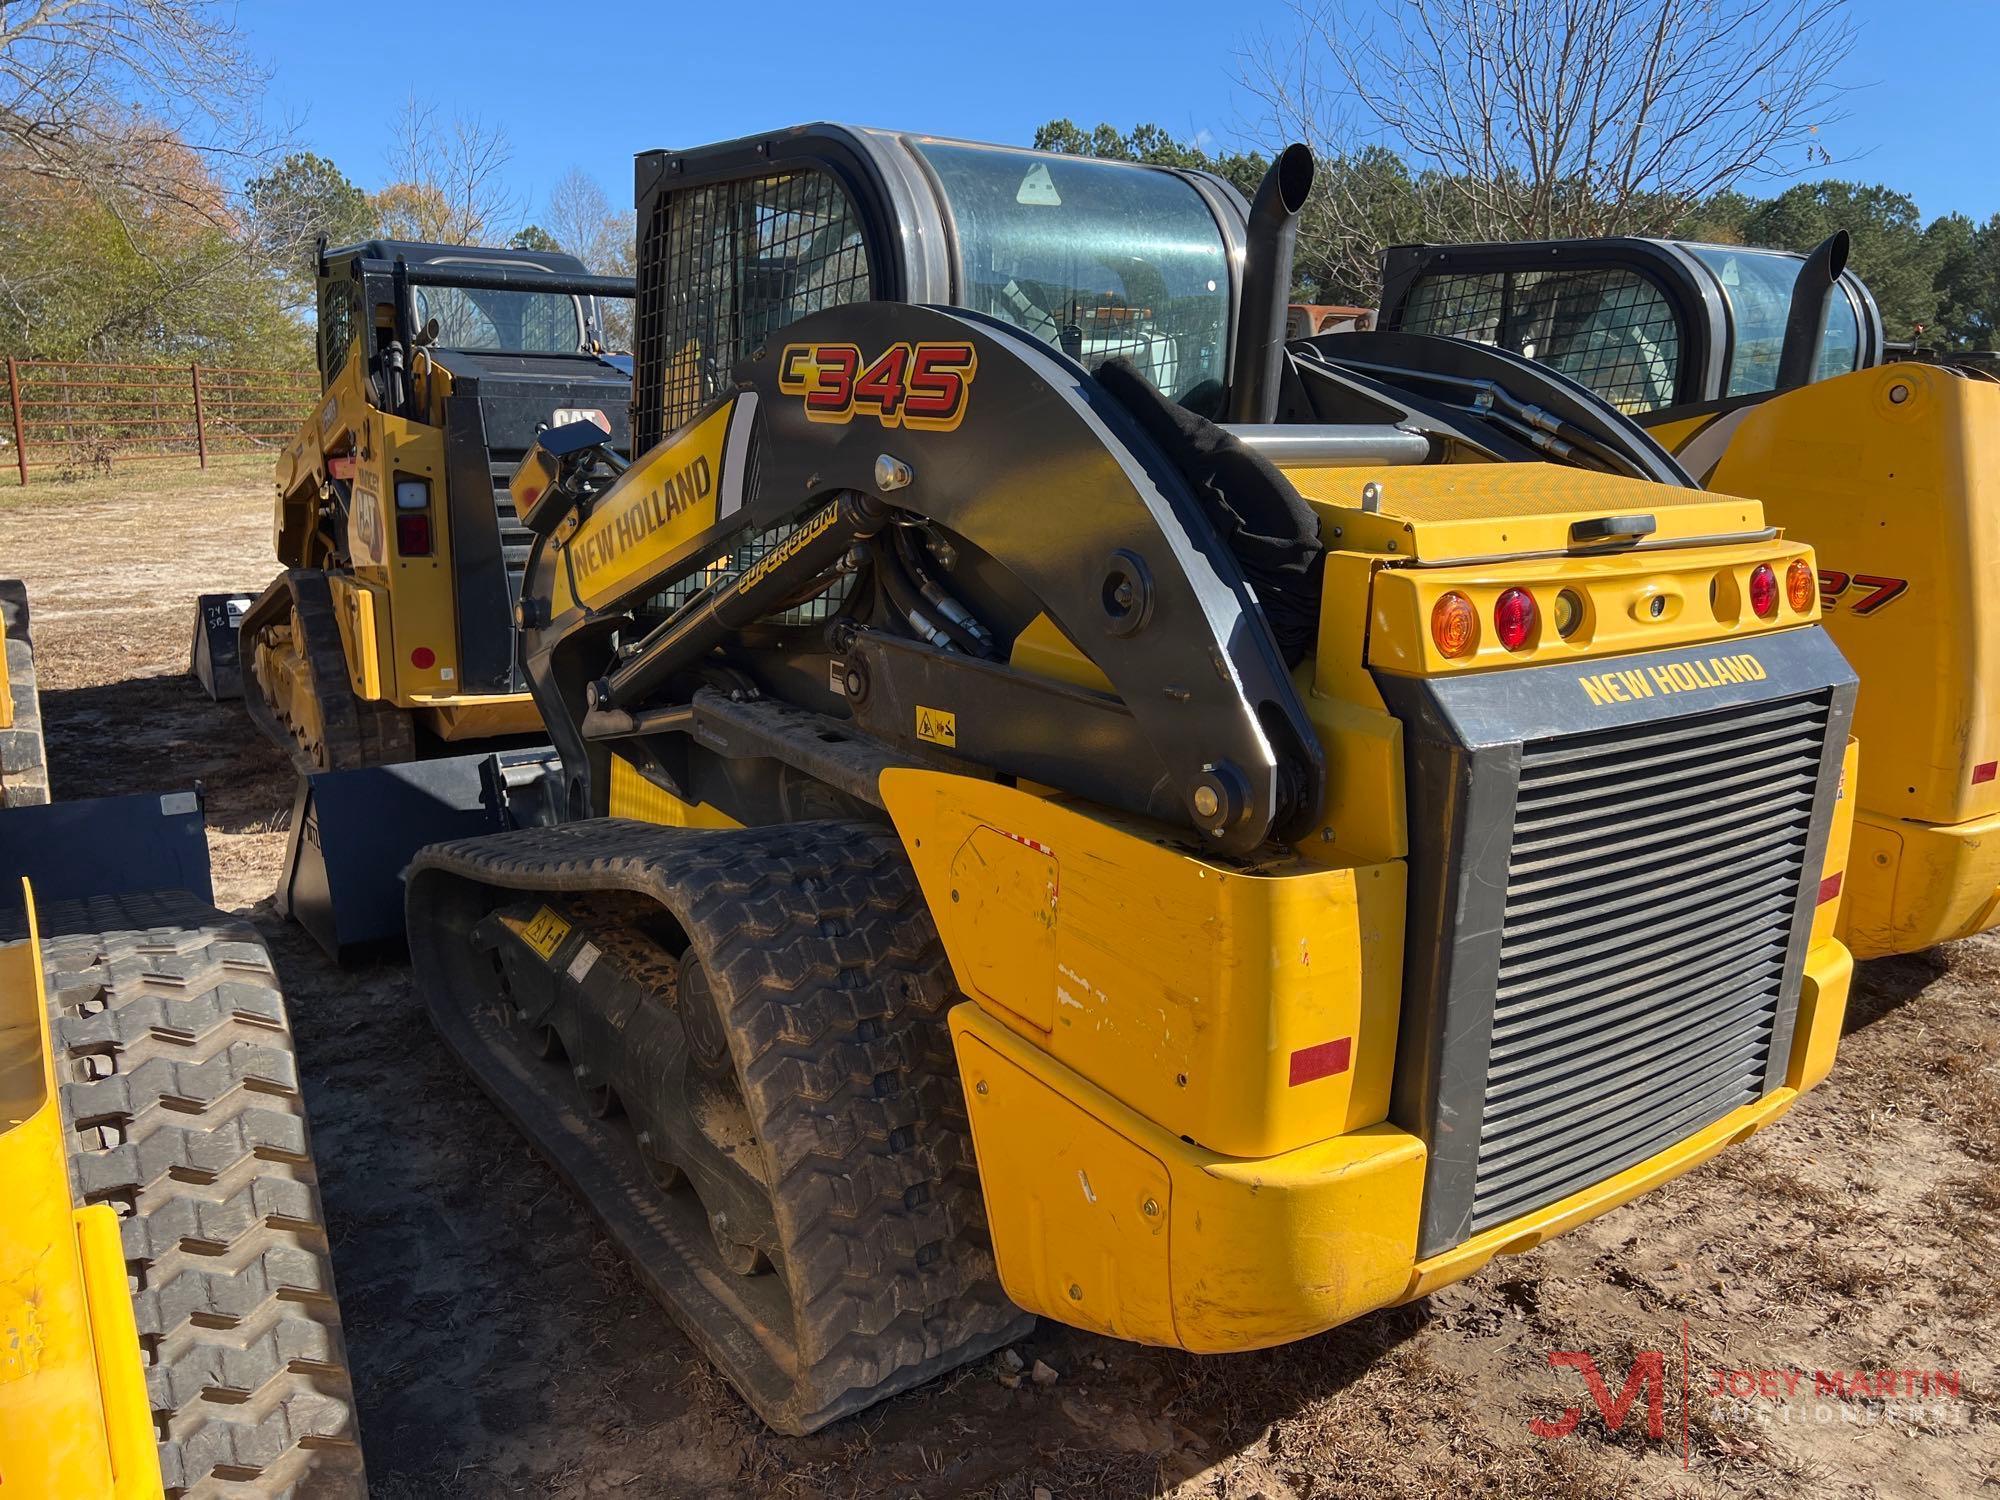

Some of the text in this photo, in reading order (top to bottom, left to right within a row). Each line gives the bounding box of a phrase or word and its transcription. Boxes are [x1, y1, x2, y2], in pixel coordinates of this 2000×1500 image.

[778, 341, 978, 432] C345
[573, 454, 711, 582] NEW HOLLAND
[1578, 653, 1766, 706] NEW HOLLAND
